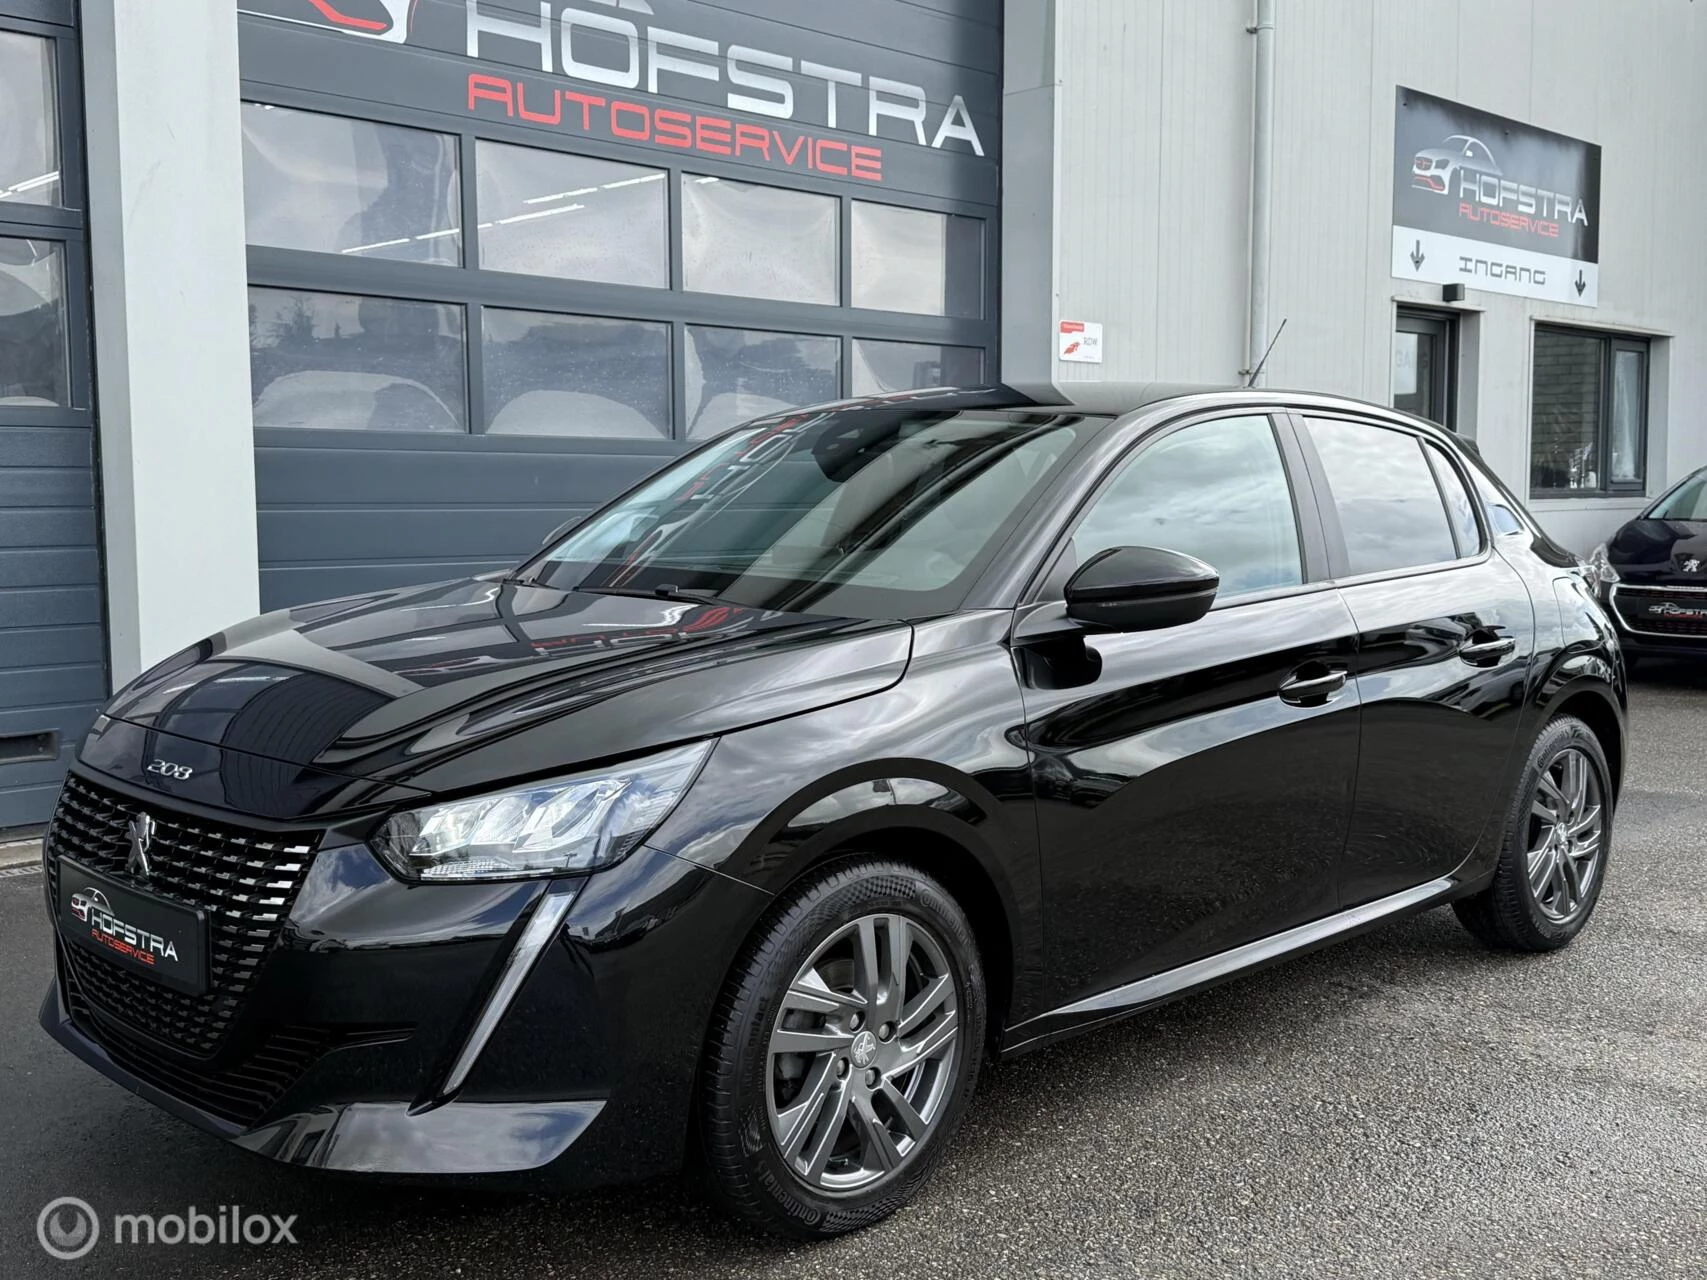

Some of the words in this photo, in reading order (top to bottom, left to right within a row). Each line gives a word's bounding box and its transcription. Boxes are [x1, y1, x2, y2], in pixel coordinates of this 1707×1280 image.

[466, 0, 984, 157] HOFSTRA
[468, 73, 883, 182] AUTOSERVICE
[1458, 203, 1559, 238] AUTOSERVICE
[1459, 169, 1588, 227] HOFSTRA
[1458, 256, 1546, 286] INGANG
[146, 759, 193, 781] 208
[91, 908, 179, 962] HOFSTRA
[91, 928, 156, 966] AUTOSERVICE
[758, 1168, 821, 1226] Continental
